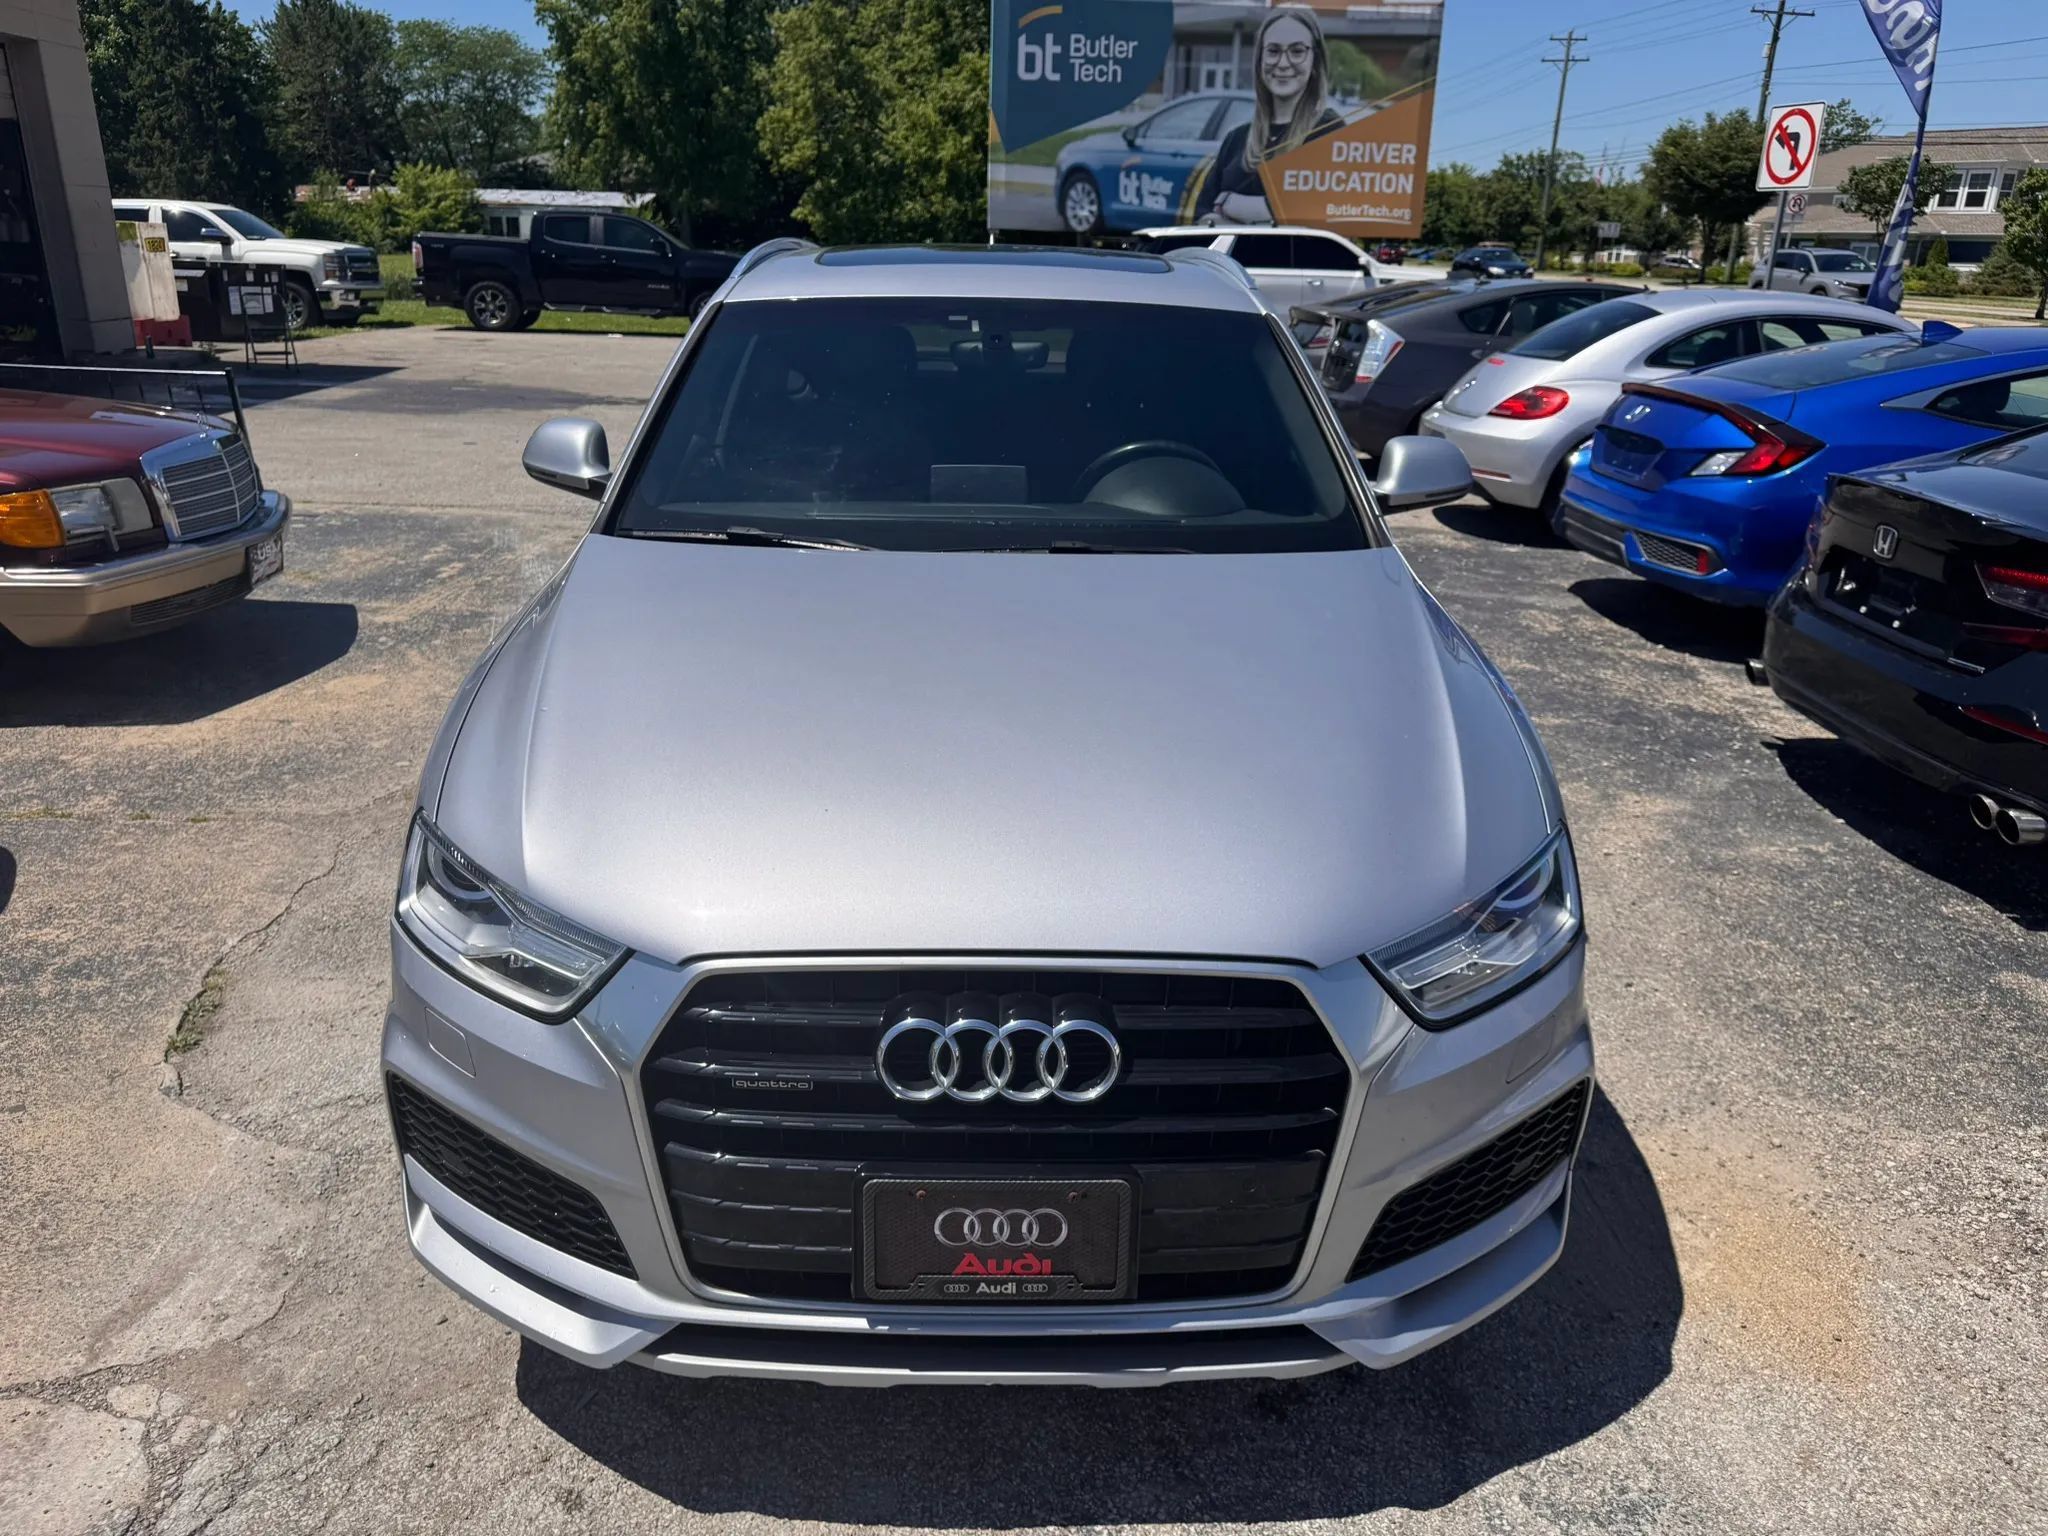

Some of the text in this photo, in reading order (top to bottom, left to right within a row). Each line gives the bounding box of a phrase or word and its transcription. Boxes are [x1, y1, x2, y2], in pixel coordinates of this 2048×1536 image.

[1069, 33, 1138, 58] Butler
[1017, 33, 1062, 82] bt
[1069, 59, 1122, 82] Tech
[1332, 141, 1417, 164] DRIVER
[1283, 169, 1414, 194] EDUCATION
[1326, 203, 1412, 220] ButlerTech.org
[735, 1080, 809, 1089] quattro
[952, 1252, 1052, 1277] Audi
[976, 1282, 1017, 1294] Audi
